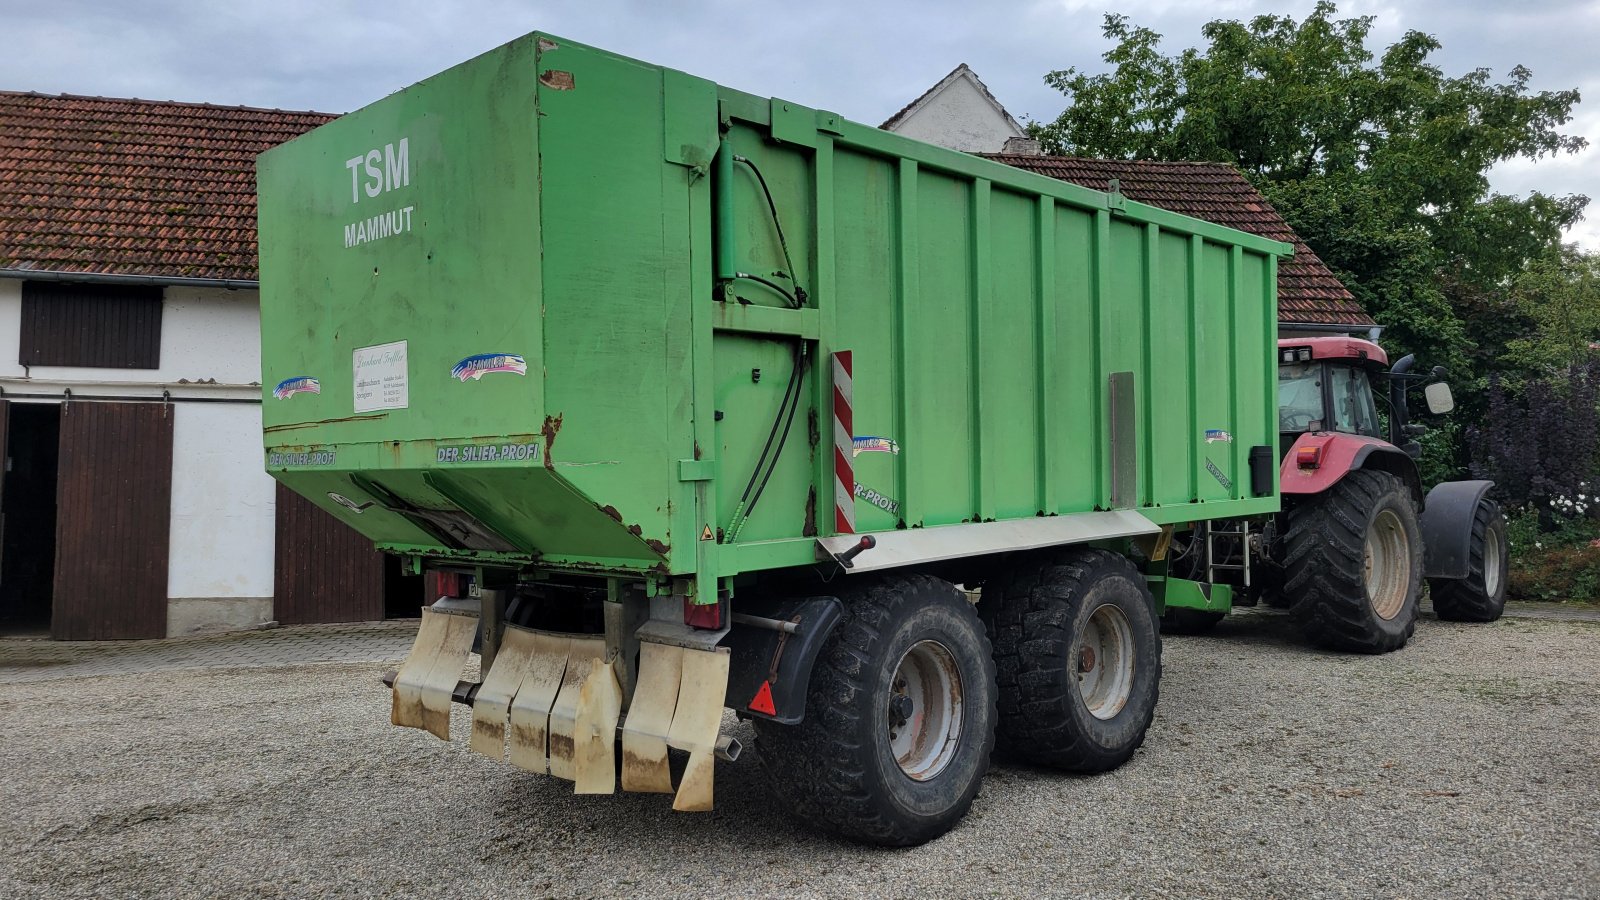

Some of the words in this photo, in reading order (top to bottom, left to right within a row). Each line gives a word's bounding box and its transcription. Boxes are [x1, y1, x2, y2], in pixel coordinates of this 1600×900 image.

[346, 137, 409, 204] TSM
[344, 206, 414, 249] MAMMUT
[466, 356, 506, 371] DEMMLER
[270, 453, 284, 465] DER
[286, 452, 336, 465] SILIER-PROFI
[437, 448, 459, 462] DER
[462, 443, 539, 461] SILIER-PROFI
